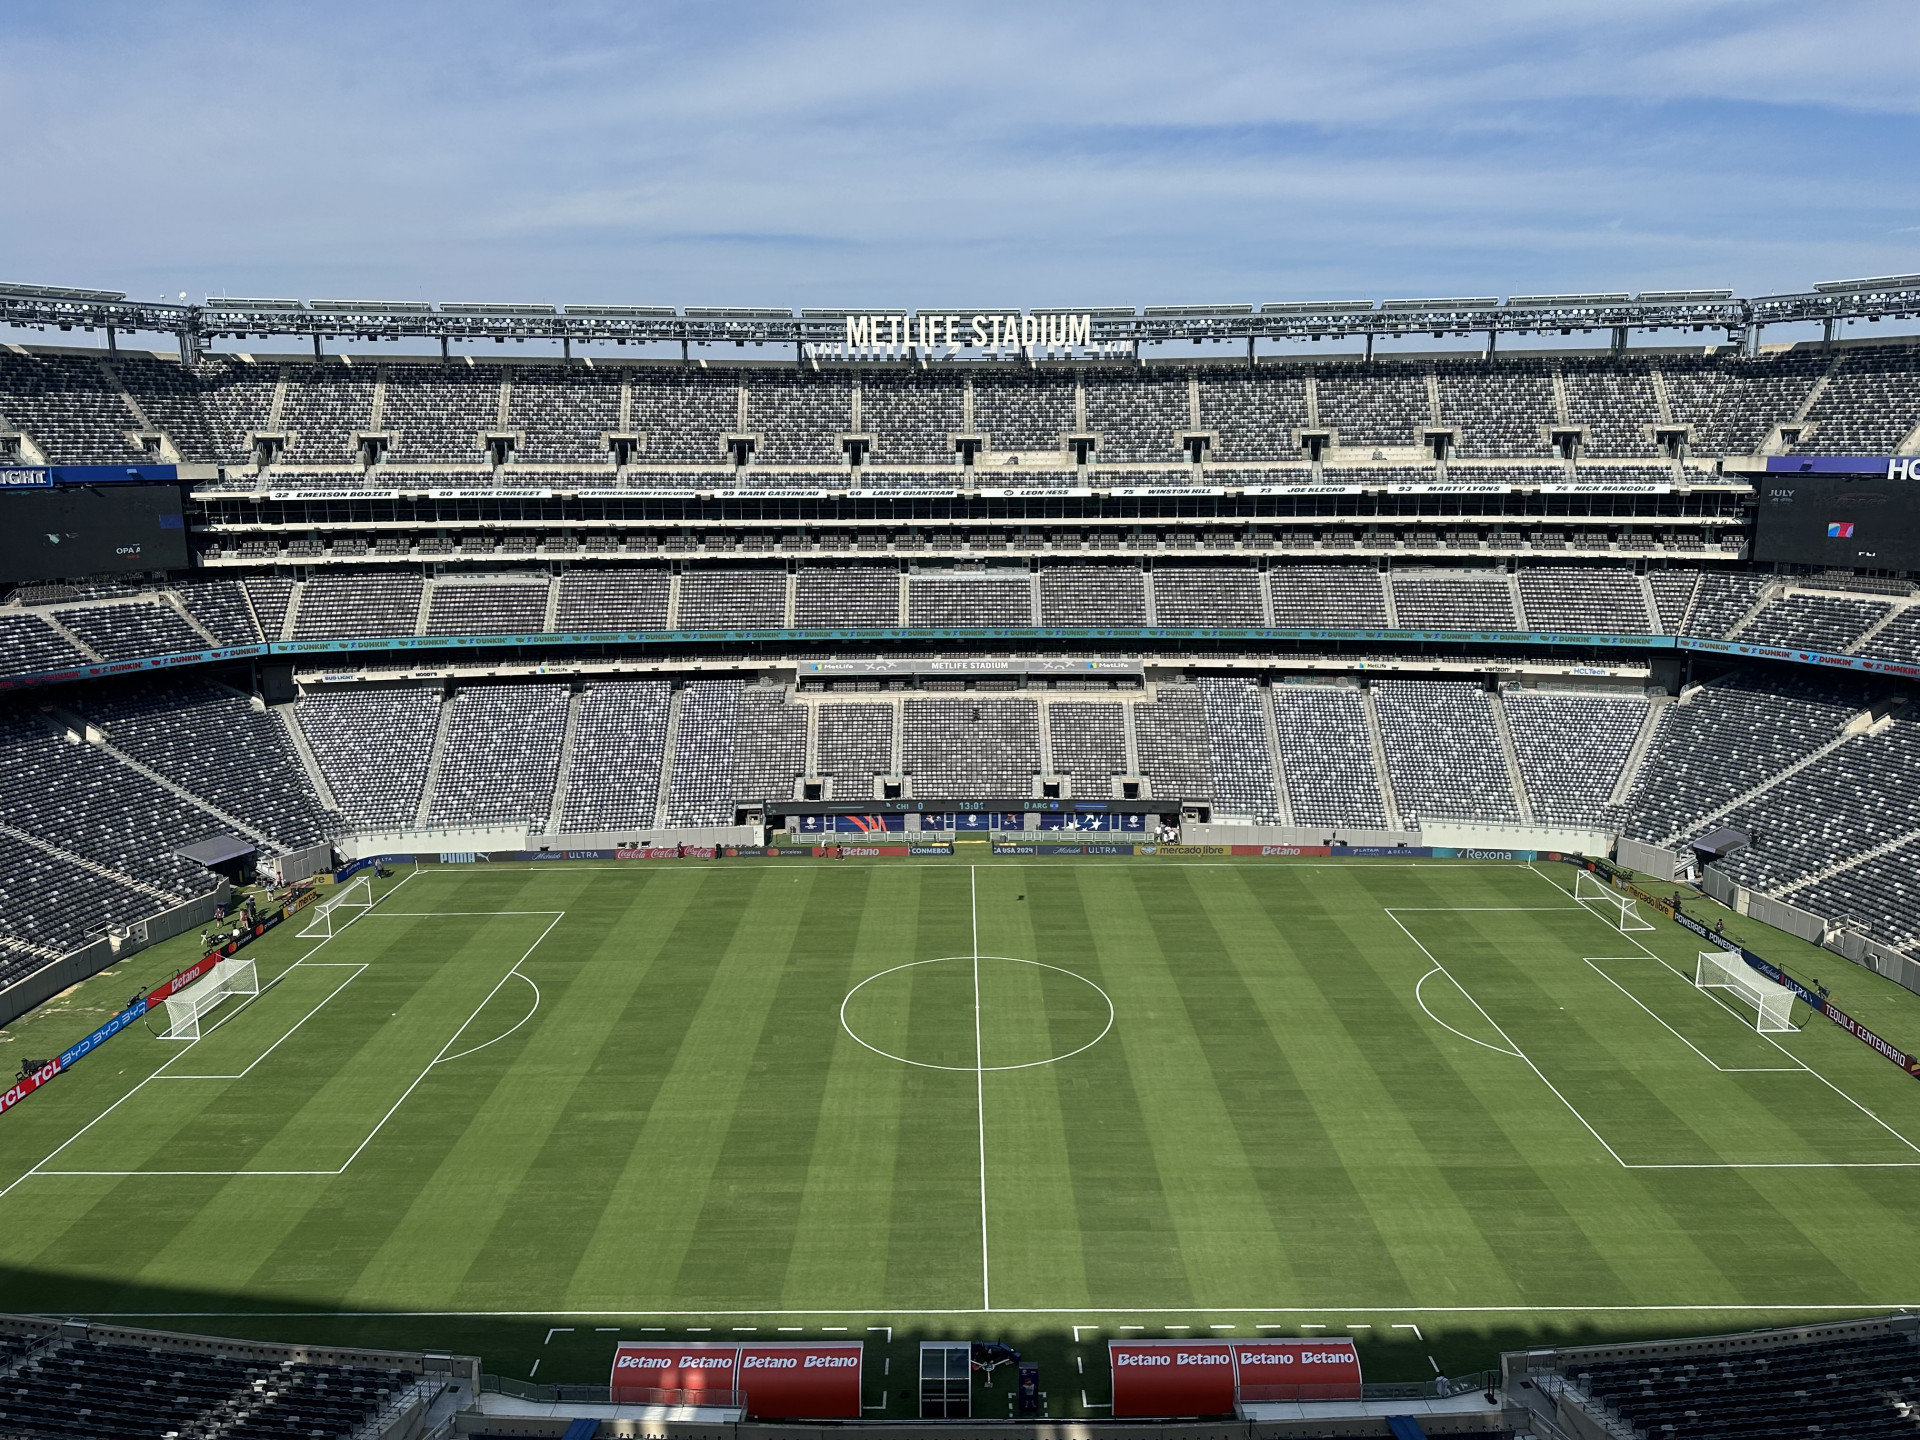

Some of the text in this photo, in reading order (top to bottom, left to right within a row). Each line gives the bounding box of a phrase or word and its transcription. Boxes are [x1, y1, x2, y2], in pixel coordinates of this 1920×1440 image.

[847, 315, 1091, 348] METLIFE STADIUM
[230, 646, 261, 656] DUNKIN'
[1698, 642, 1731, 650] DUNKIN'
[170, 654, 203, 664] DUNKIN'
[1758, 648, 1792, 658] DUNKIN'
[110, 661, 142, 672] DUNKIN'
[1819, 656, 1854, 666] DUNKIN'
[1884, 664, 1920, 675] DUNKIN'
[568, 851, 599, 859] ULTRA
[842, 848, 880, 856] Betano
[1160, 846, 1224, 855] mercado libre
[1262, 846, 1300, 856] Betano
[1466, 849, 1512, 860] Rexona
[440, 852, 476, 864] PUMA
[1630, 886, 1669, 914] mercado libre
[1674, 912, 1707, 936] POWERADE
[172, 966, 200, 992] Betano
[1784, 978, 1808, 1000] ULTRA
[93, 1020, 119, 1045] BYD
[1826, 1004, 1906, 1067] TEQUILA CENTENARIO
[62, 1041, 90, 1066] BYD
[32, 1060, 62, 1088] TCL
[618, 1356, 672, 1368] Betano
[678, 1356, 732, 1368] Betano
[743, 1356, 798, 1368] Betano
[804, 1356, 858, 1368] Betano
[1118, 1354, 1171, 1366] Betano
[1176, 1353, 1229, 1365] Betano
[1240, 1352, 1294, 1364] Betano
[1301, 1352, 1354, 1364] Betano
